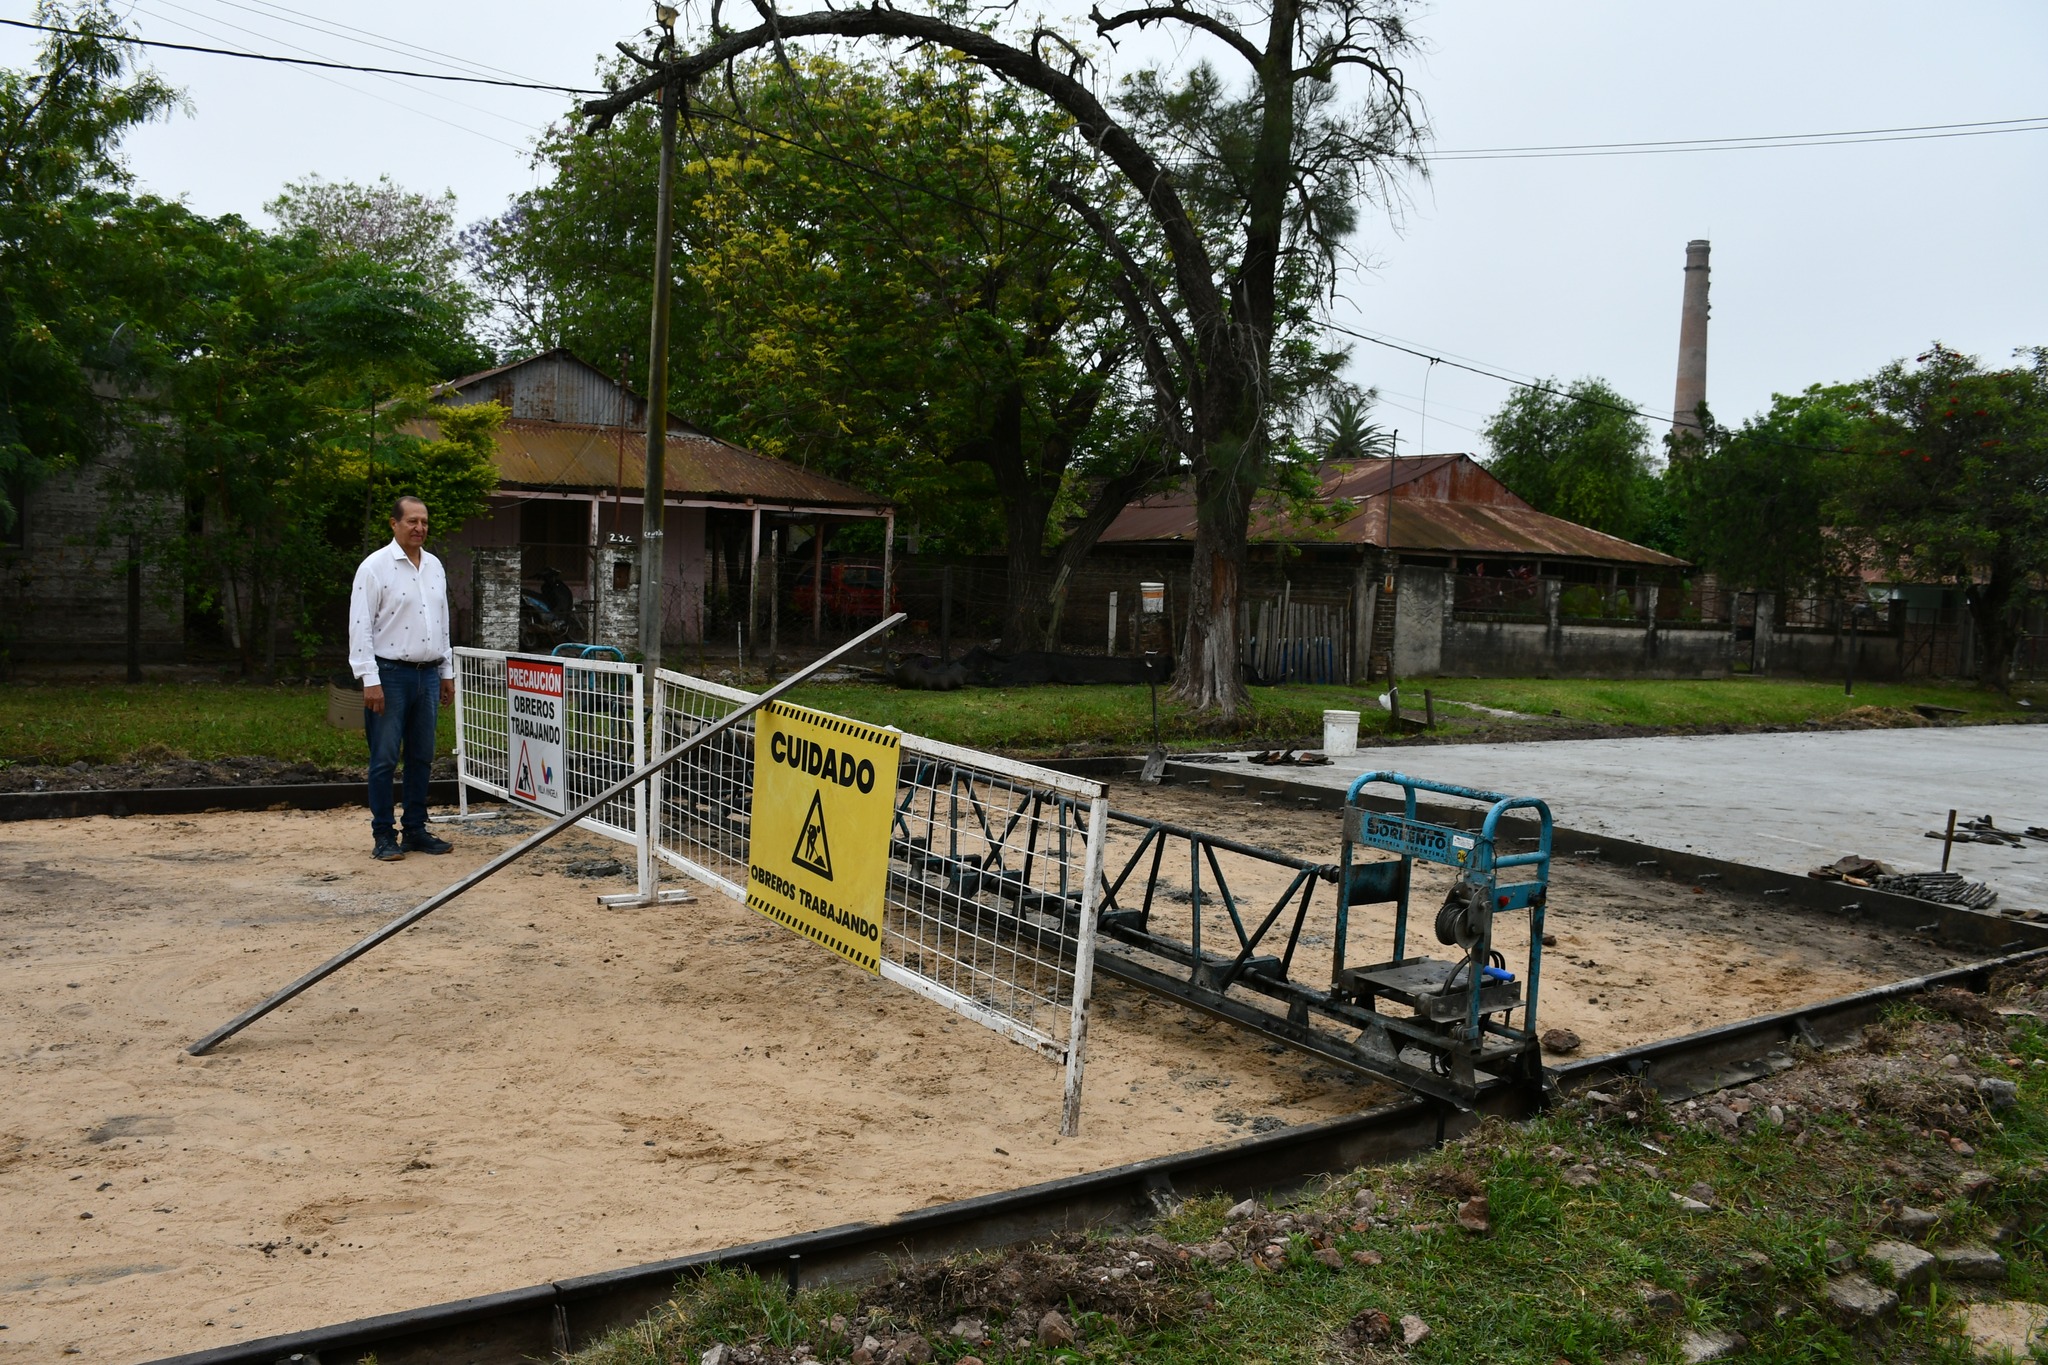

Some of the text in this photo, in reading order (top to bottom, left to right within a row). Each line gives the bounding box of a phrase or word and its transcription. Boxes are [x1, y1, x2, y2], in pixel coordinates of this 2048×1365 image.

[508, 667, 561, 693] PRECAUCIÓN
[514, 695, 555, 720] OBREROS
[511, 716, 560, 745] TRABAJANDO
[771, 731, 875, 794] CUIDADO
[751, 864, 878, 942] OBREROS TRABAJANDO
